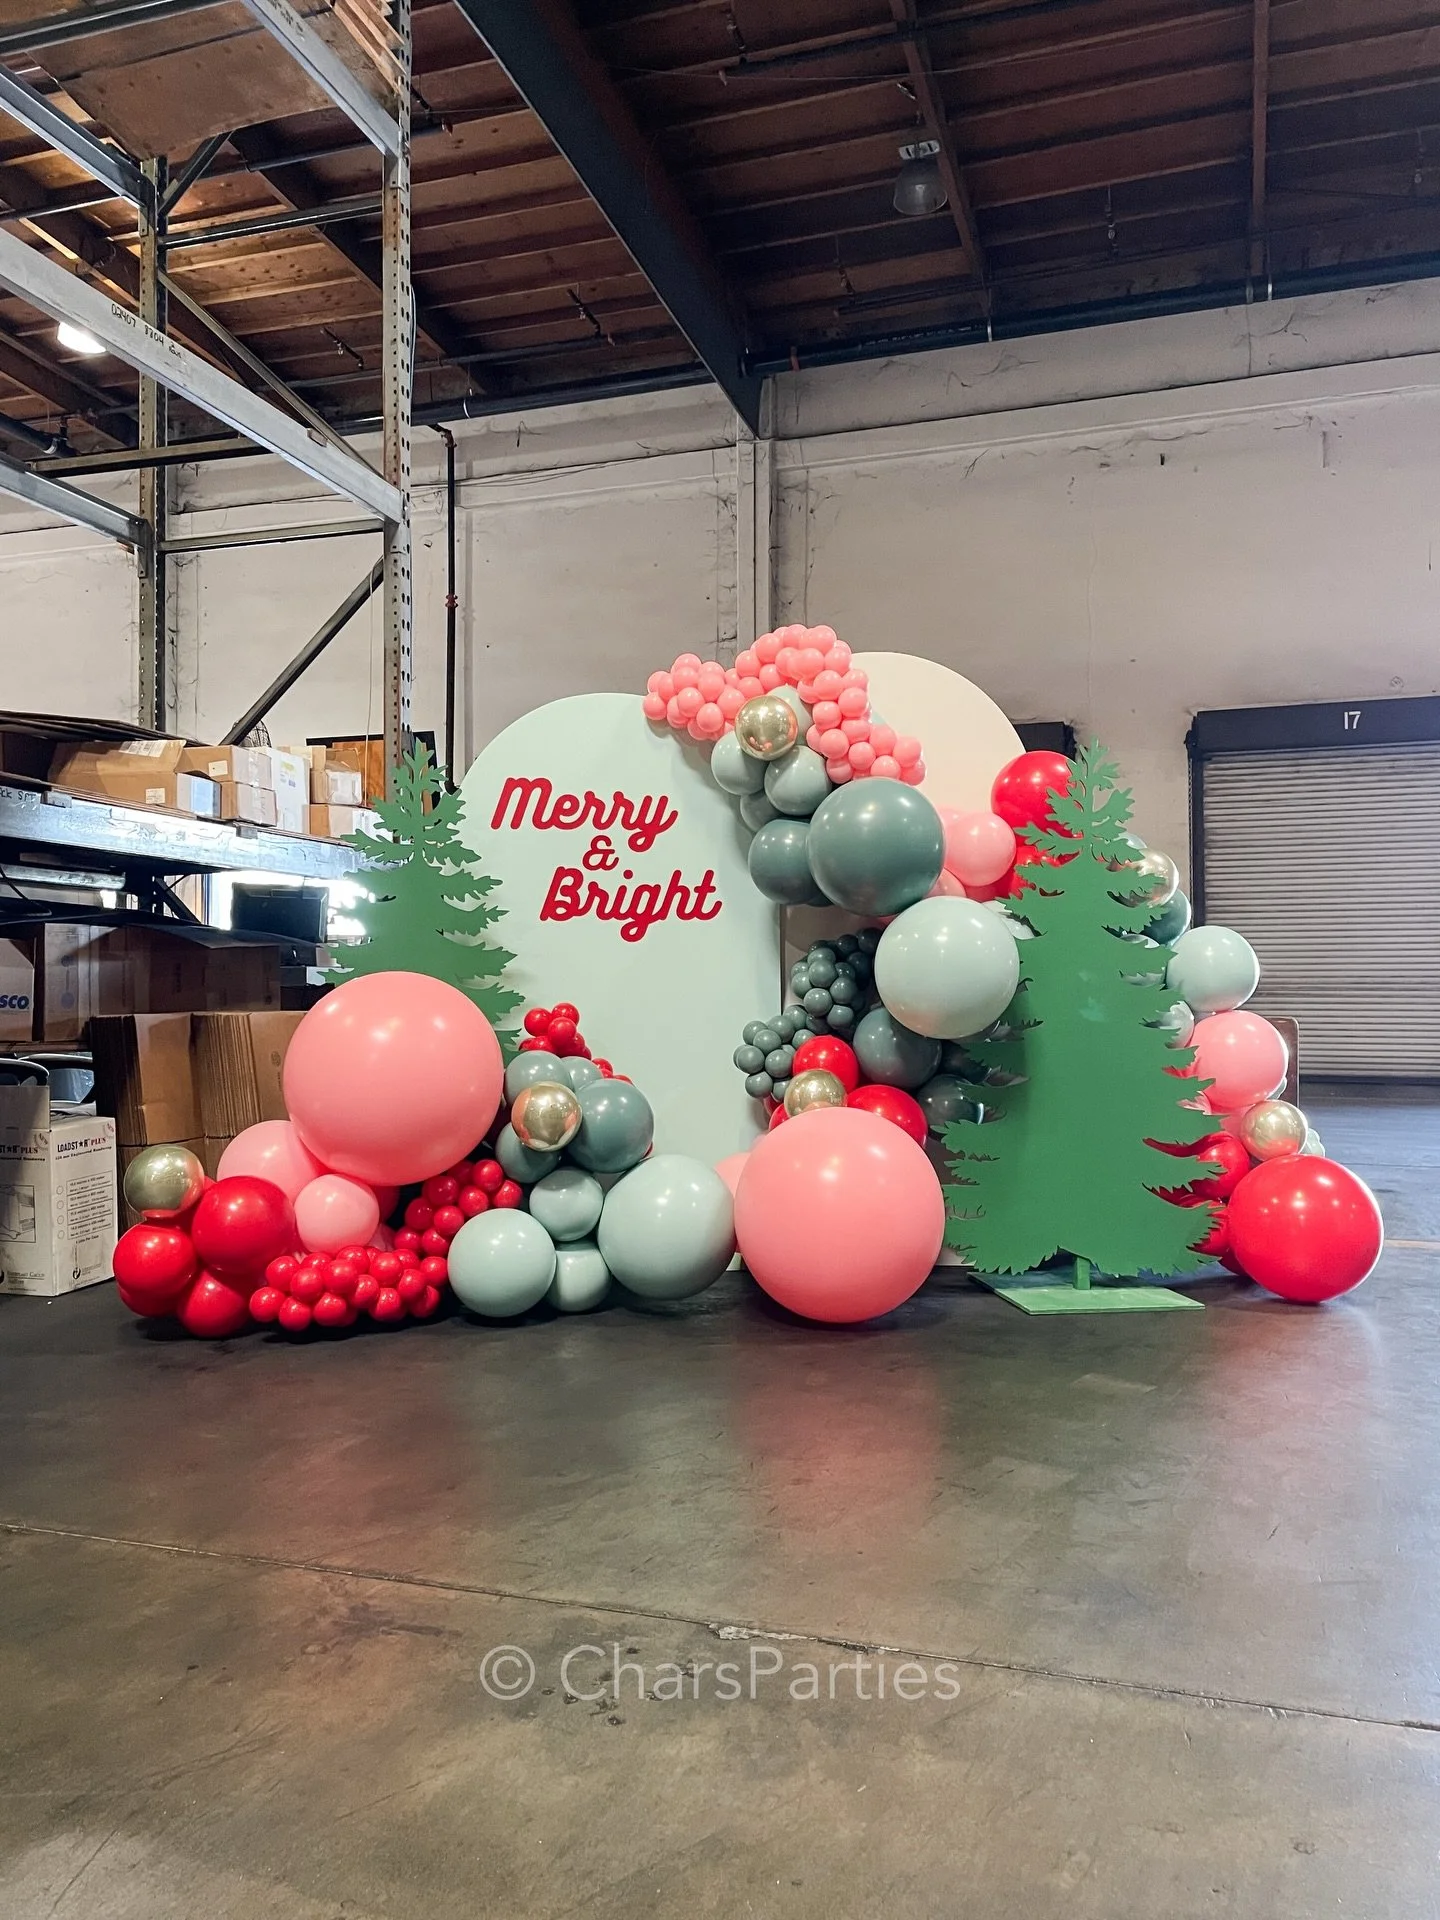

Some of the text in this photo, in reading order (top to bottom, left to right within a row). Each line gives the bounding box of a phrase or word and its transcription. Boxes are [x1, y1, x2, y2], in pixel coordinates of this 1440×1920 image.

[1343, 710, 1361, 730] 17
[490, 777, 679, 852] Merry
[582, 835, 619, 871] &
[539, 866, 723, 942] Bright
